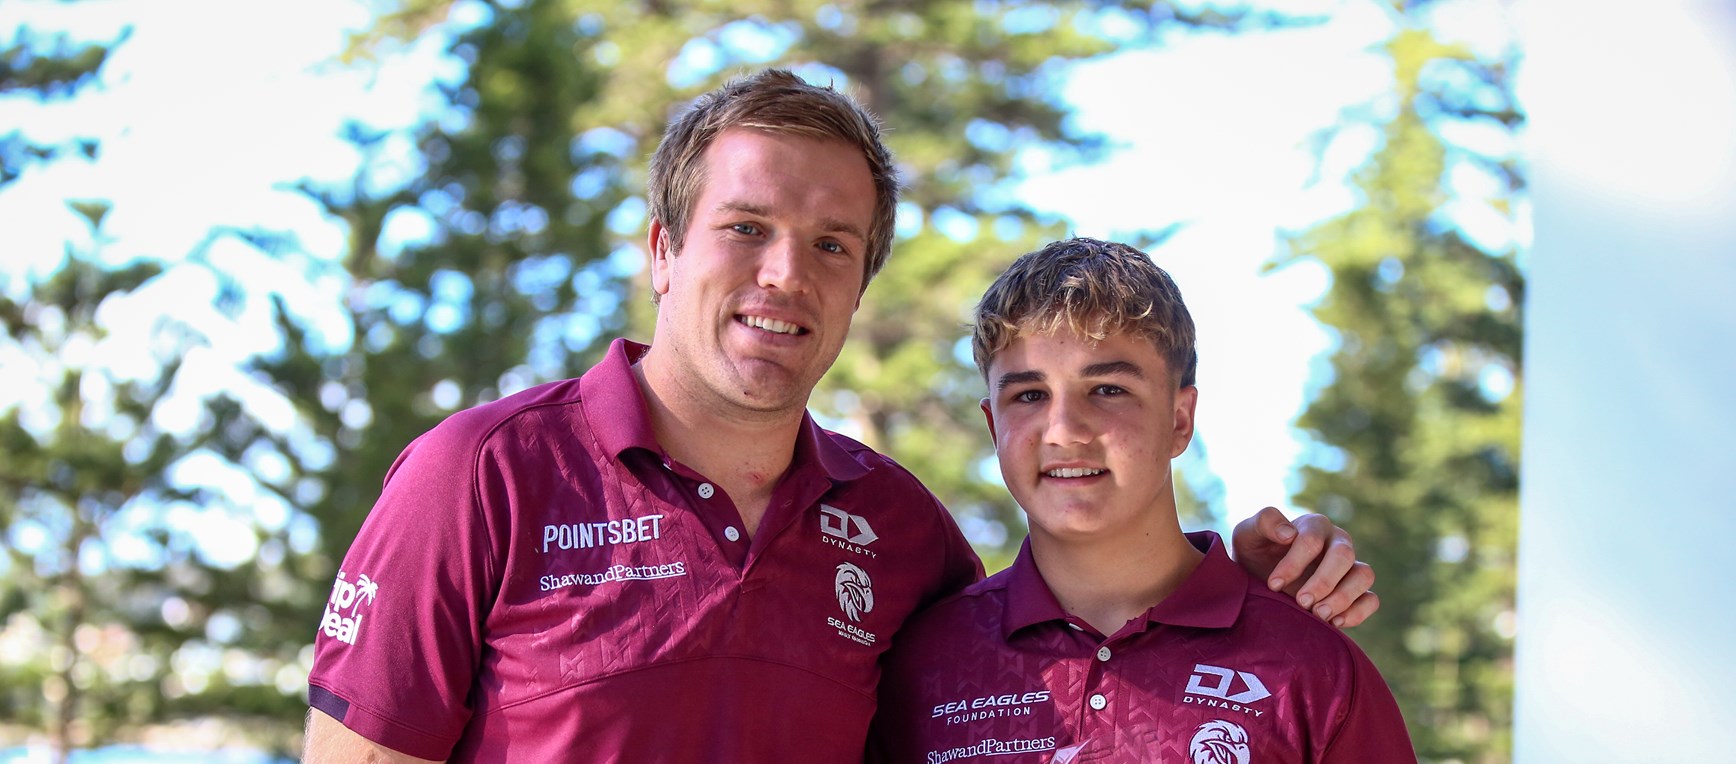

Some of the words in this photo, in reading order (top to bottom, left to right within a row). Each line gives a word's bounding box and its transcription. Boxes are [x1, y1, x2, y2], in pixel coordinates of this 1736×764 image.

[543, 514, 664, 553] POINTSBET
[822, 535, 877, 559] DYNASTY
[540, 561, 687, 592] ShawandPartners
[827, 616, 846, 631] SEA
[847, 624, 876, 643] EAGLES
[931, 699, 968, 719] SEA
[971, 690, 1050, 710] EAGLES
[946, 706, 1031, 726] FOUNDATION
[1183, 696, 1264, 717] DYNASTY
[927, 736, 1056, 764] ShawandPartners
